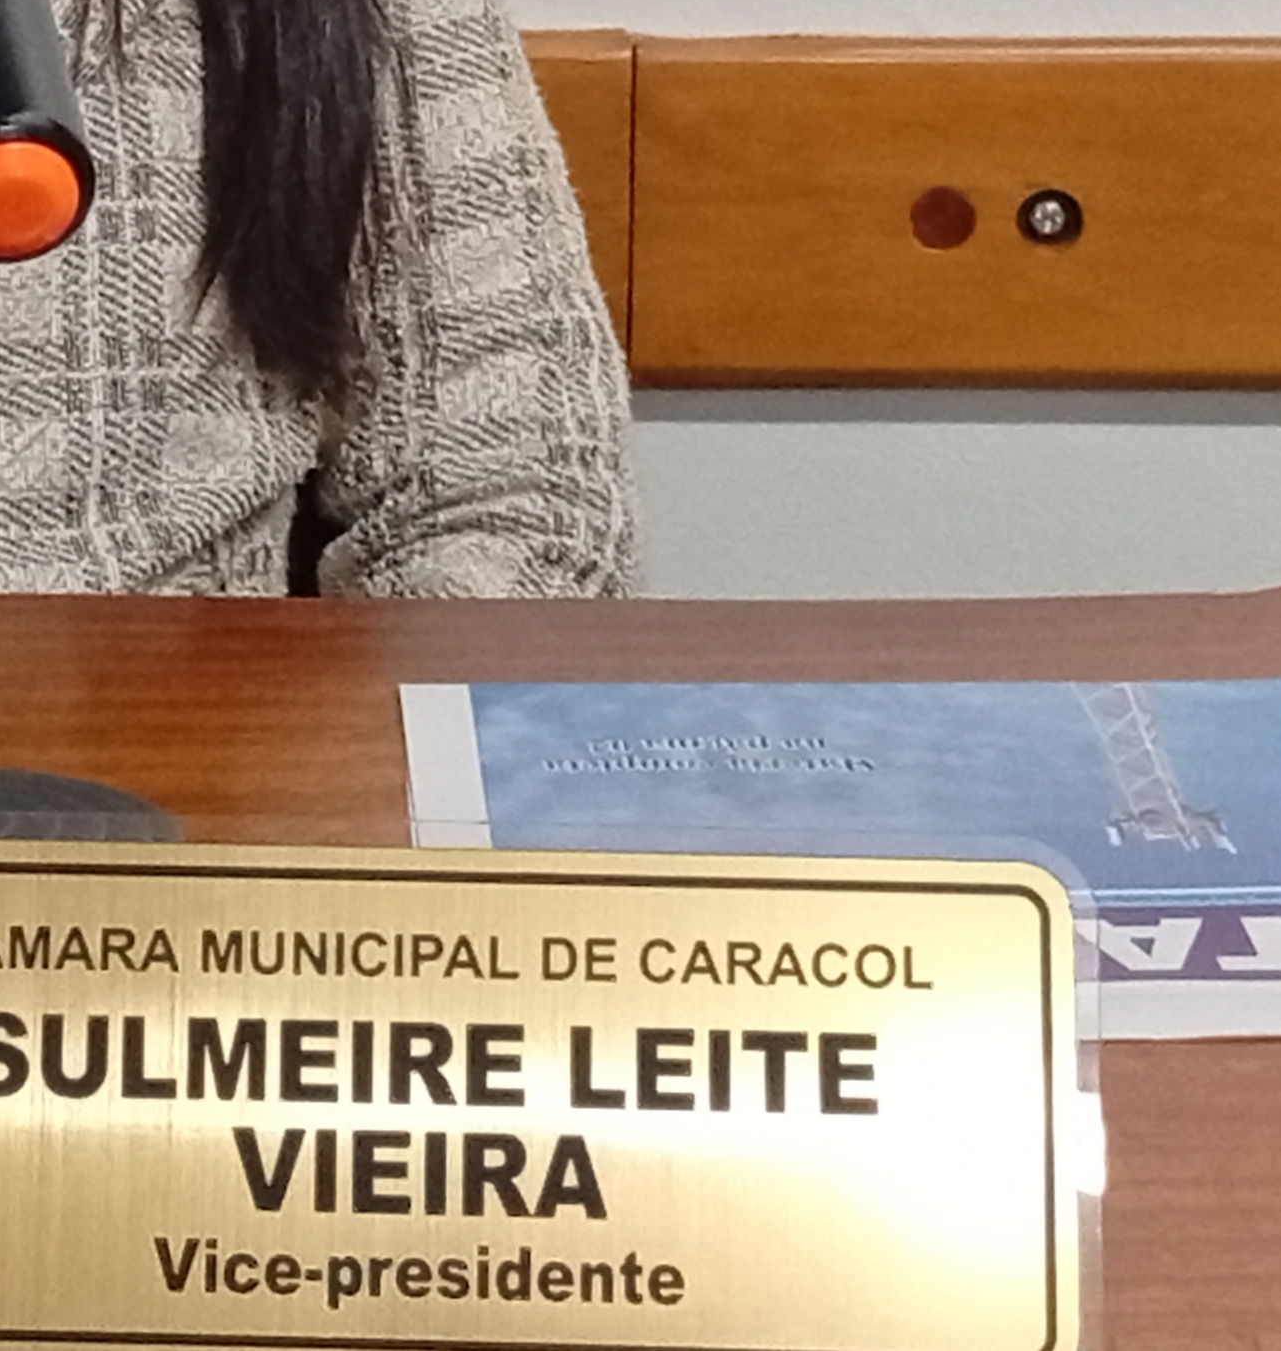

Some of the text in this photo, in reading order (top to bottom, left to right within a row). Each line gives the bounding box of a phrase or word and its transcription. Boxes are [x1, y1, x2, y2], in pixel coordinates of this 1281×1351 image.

[201, 929, 520, 979] MUNICIPAL
[541, 936, 617, 982] DE
[639, 938, 934, 990] CARACOL
[570, 1025, 879, 1115] LEITE
[232, 1126, 608, 1219] VIEIRA
[154, 1236, 686, 1309] Vice-presidente
